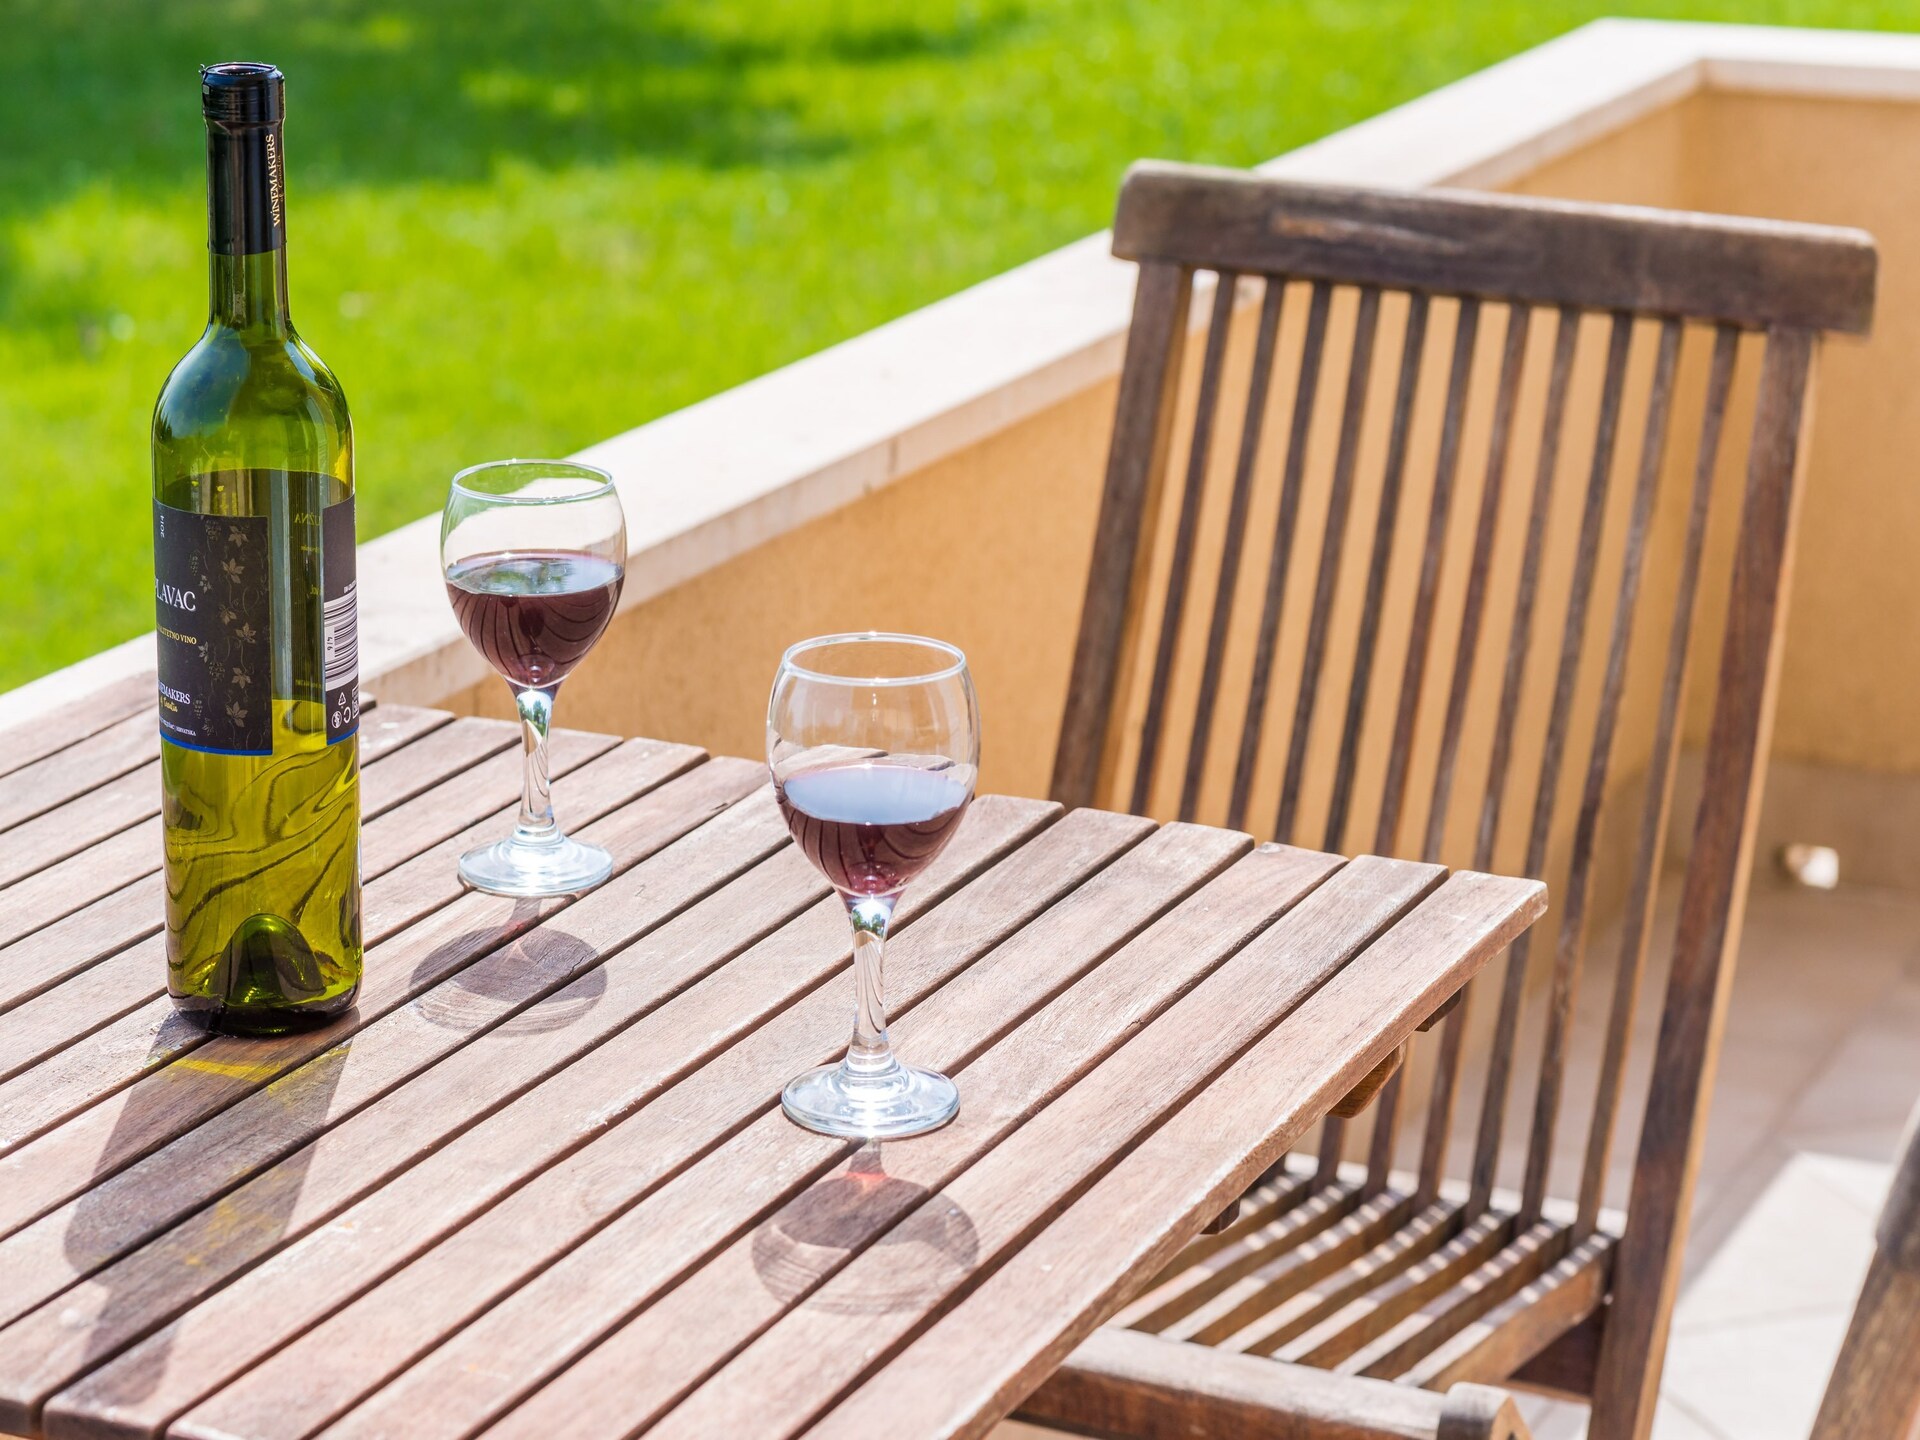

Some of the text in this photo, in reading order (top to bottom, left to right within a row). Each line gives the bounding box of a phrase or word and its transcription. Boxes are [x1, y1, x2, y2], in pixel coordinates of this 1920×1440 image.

[266, 133, 281, 228] WINEMAKERS
[155, 578, 197, 612] LAVAC
[180, 634, 197, 645] VINO
